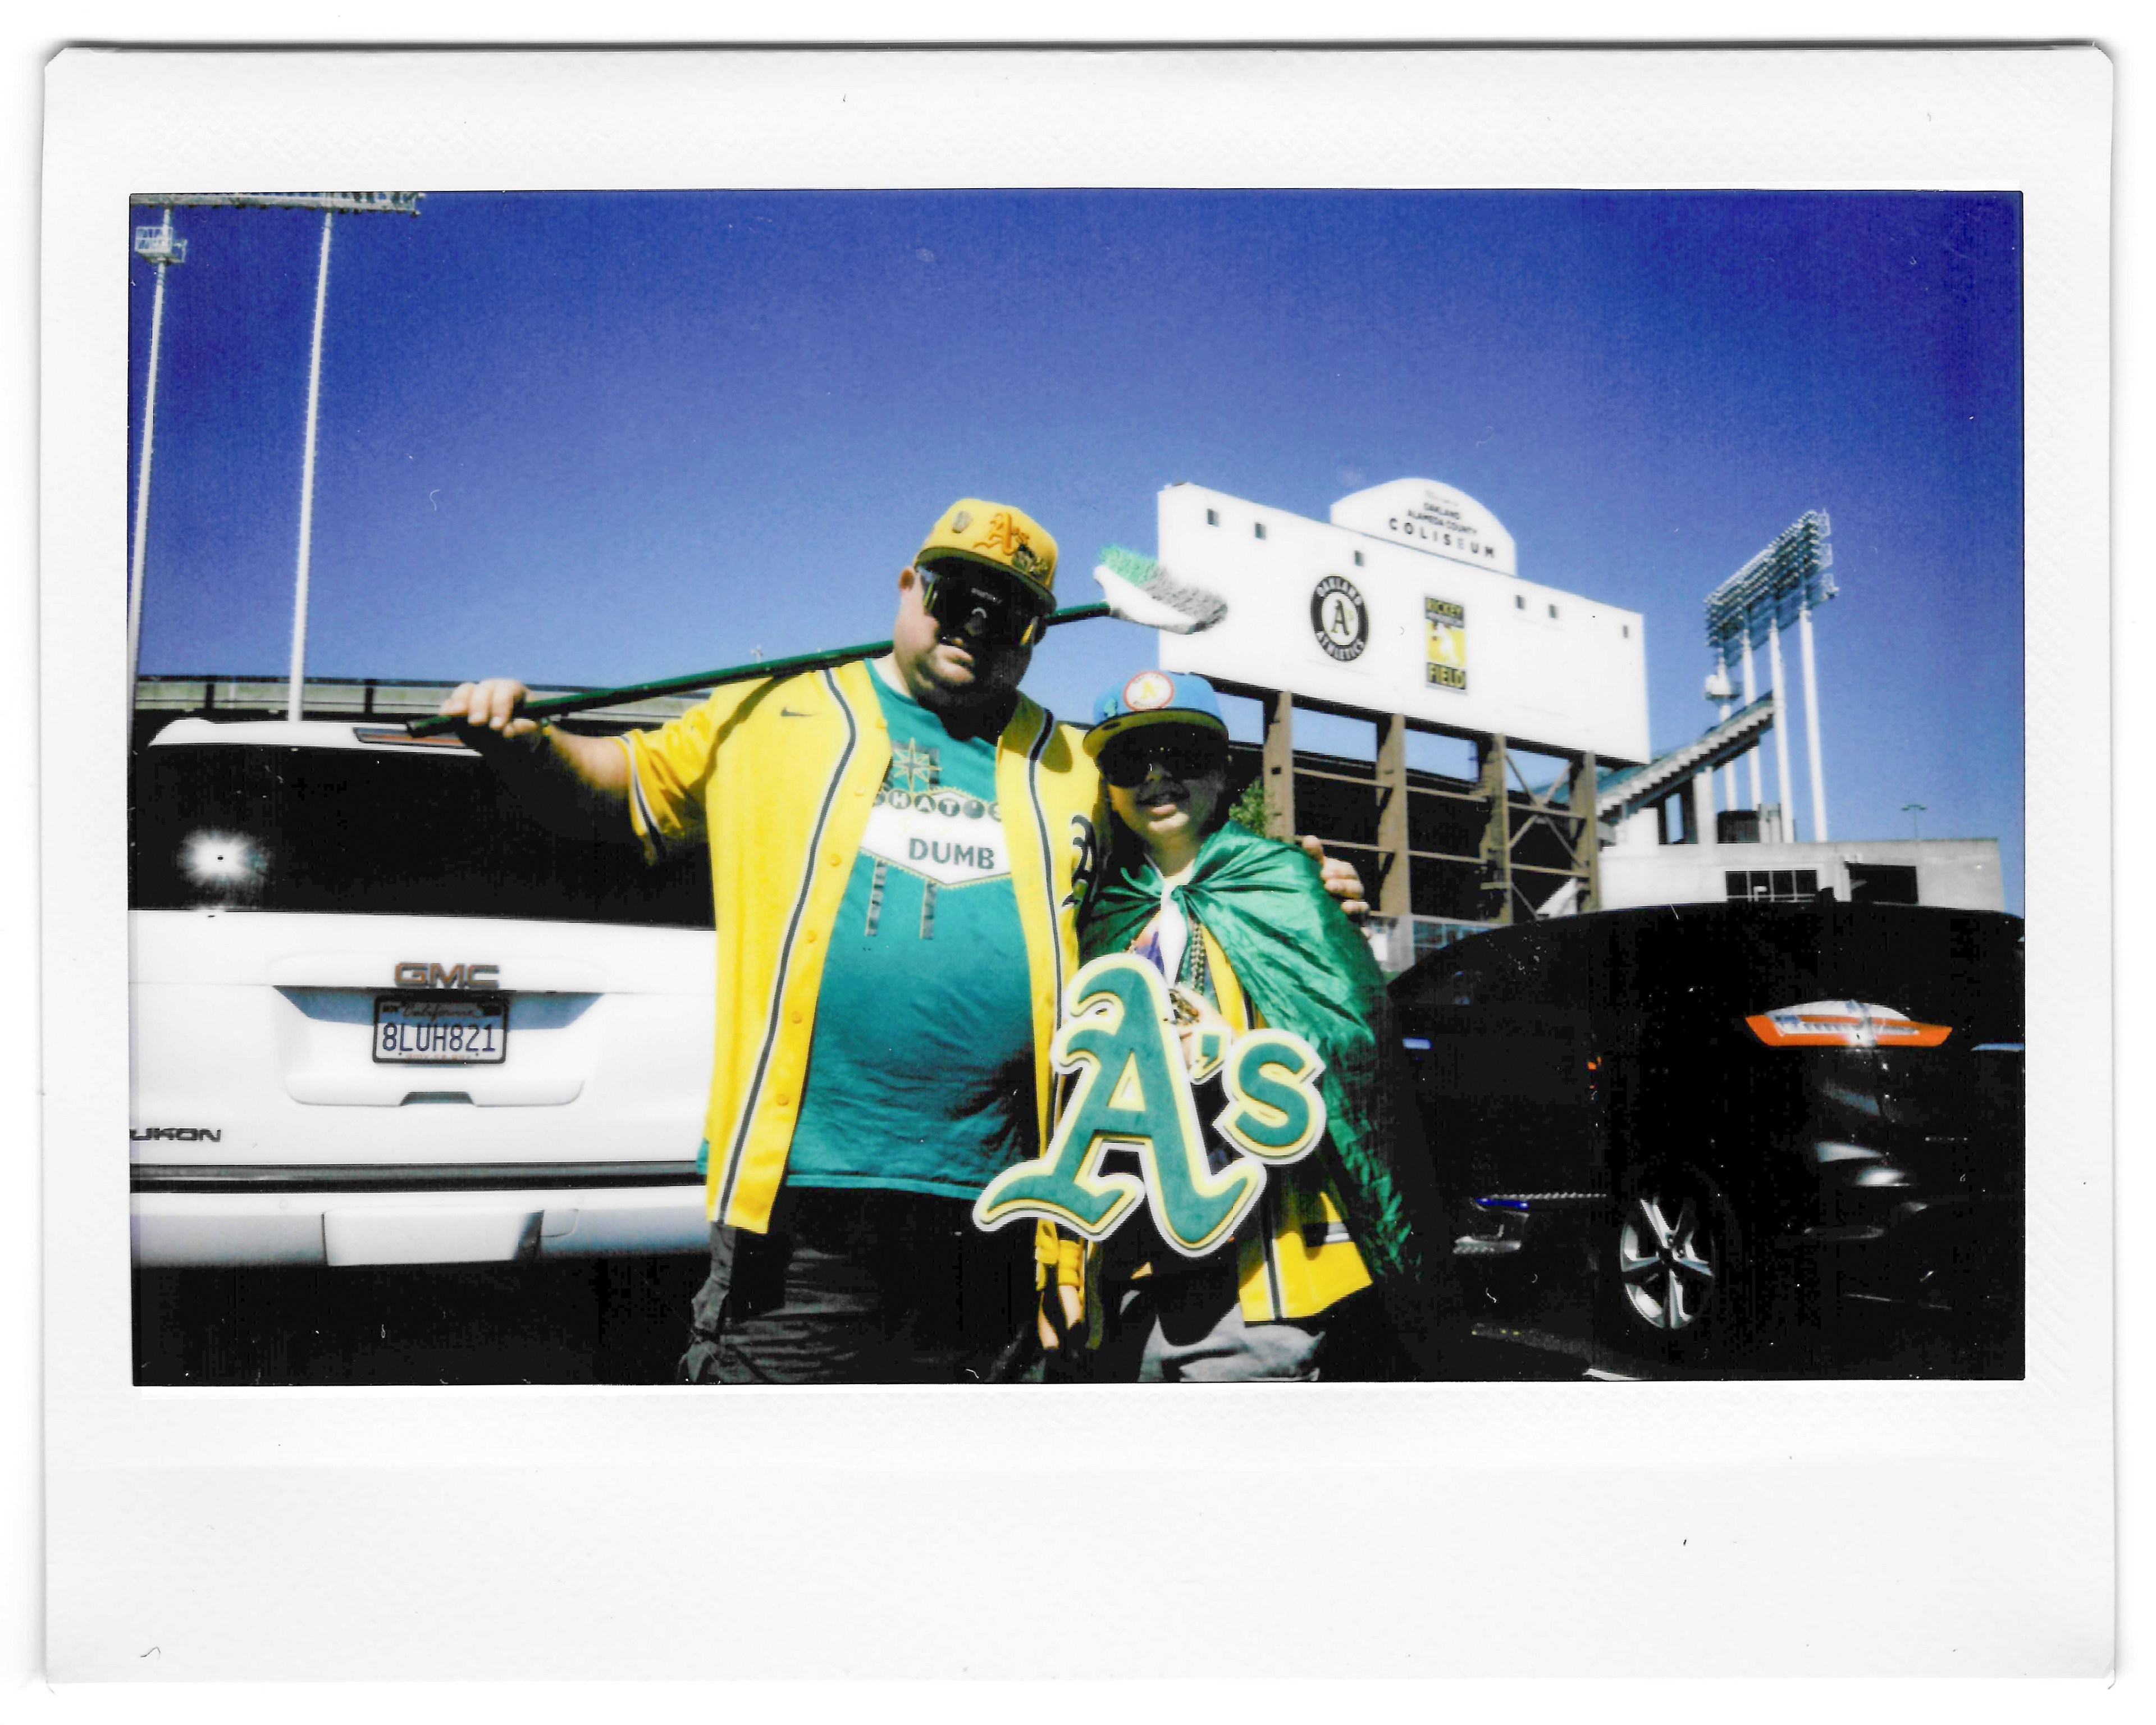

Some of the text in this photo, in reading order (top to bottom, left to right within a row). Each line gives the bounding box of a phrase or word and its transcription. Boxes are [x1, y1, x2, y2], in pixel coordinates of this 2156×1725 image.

[1389, 518, 1495, 558] COLISEUM
[1316, 577, 1363, 606] OAKLAND
[1316, 631, 1365, 659] ATHLETICS
[1429, 663, 1465, 689] FIELD
[874, 791, 1002, 822] HAT'S
[908, 838, 994, 870] DUMB
[395, 962, 500, 989] GMC
[382, 1023, 496, 1051] 8LUH821
[974, 953, 1326, 1257] A's
[129, 1128, 221, 1142] UKON
